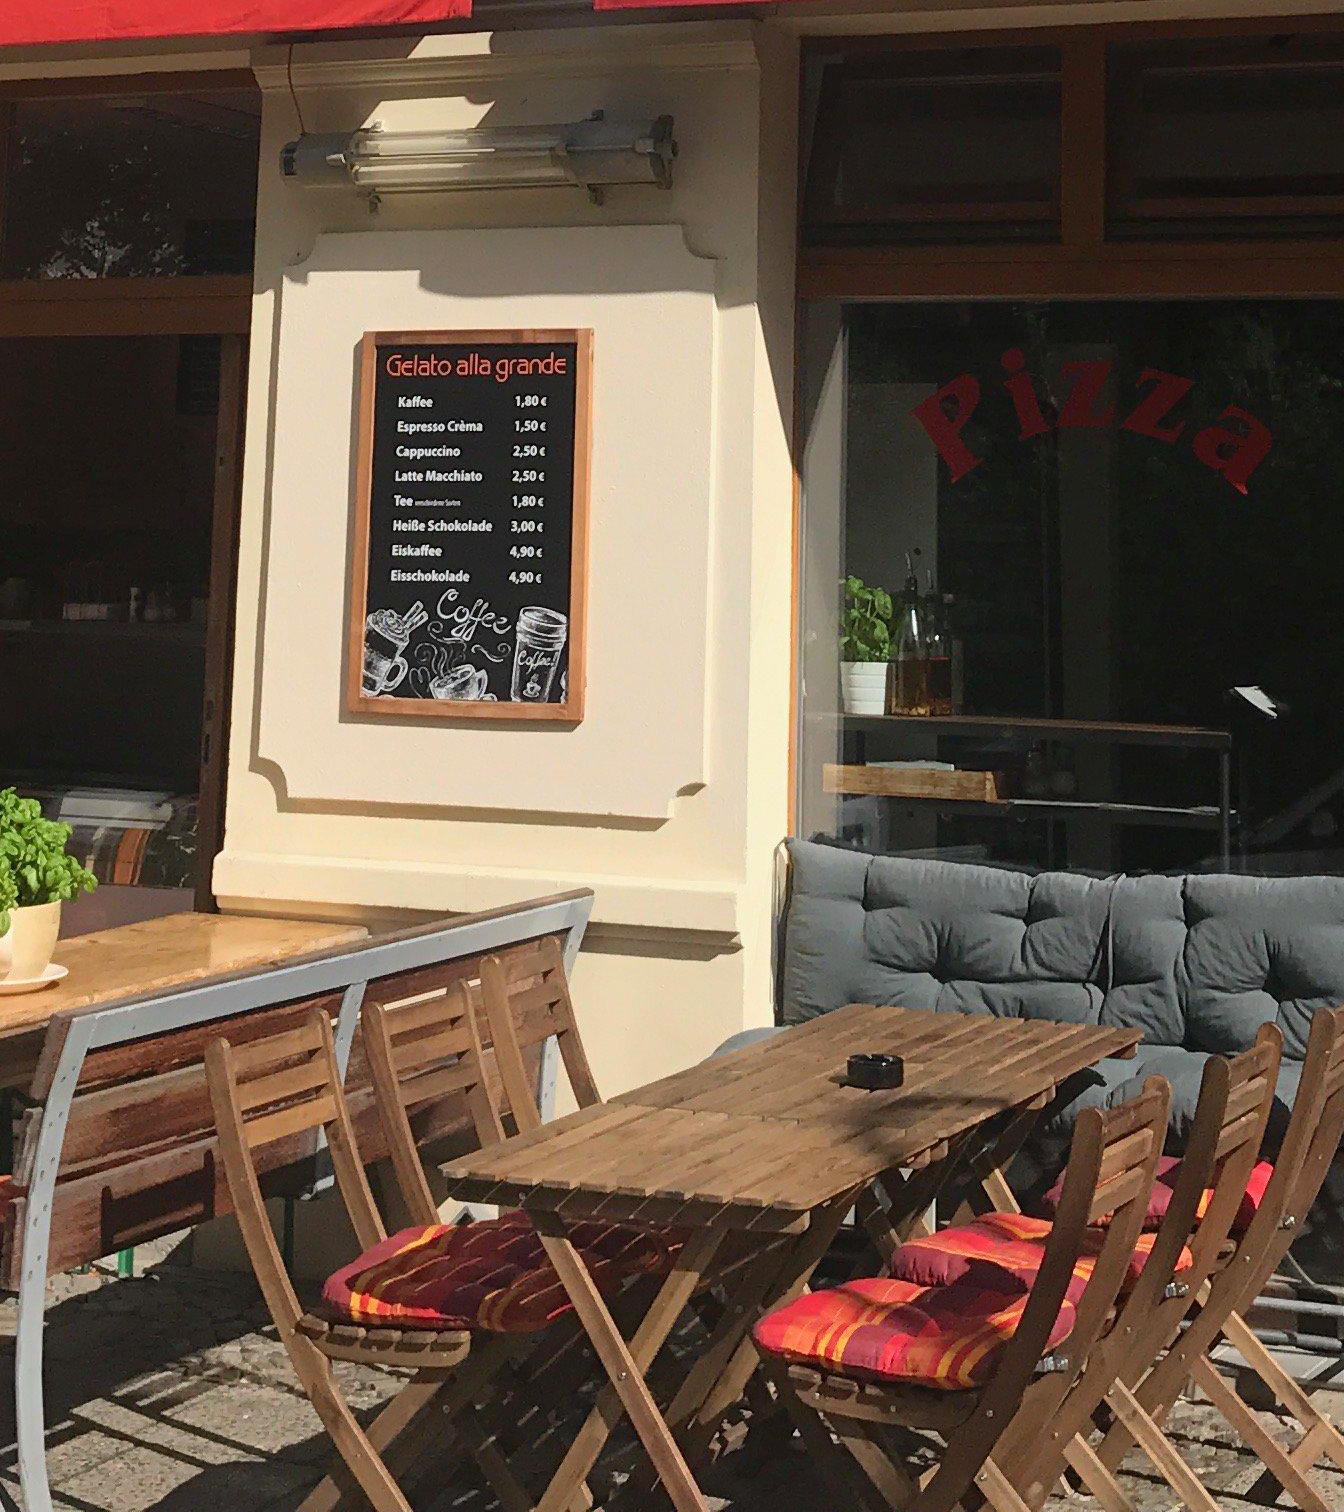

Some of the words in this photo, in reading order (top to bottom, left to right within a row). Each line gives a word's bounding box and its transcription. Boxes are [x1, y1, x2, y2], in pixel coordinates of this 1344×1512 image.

[386, 354, 451, 377] Gelato
[456, 353, 491, 376] alla
[495, 351, 566, 383] grande
[398, 396, 433, 407] Kaffee
[515, 395, 539, 408] 1,80
[397, 421, 445, 435] Espresso
[514, 420, 538, 433] 1,50
[909, 347, 1273, 495] Pizza
[396, 445, 460, 459] Cappuccino
[513, 445, 537, 458] 2,50
[395, 470, 423, 481] Latte
[425, 470, 482, 482] Macchiato
[512, 470, 536, 483] 2,50
[394, 495, 413, 506] Tee
[512, 496, 536, 508] 1,80
[393, 519, 425, 531] Heiße
[427, 519, 493, 531] Schokolade
[511, 521, 535, 533] 3,00
[392, 544, 442, 556] Eiskaffee
[510, 546, 534, 558] 4,90
[390, 569, 470, 582] Eisschokolade
[508, 571, 533, 584] 4,90
[436, 588, 512, 642] Coffee
